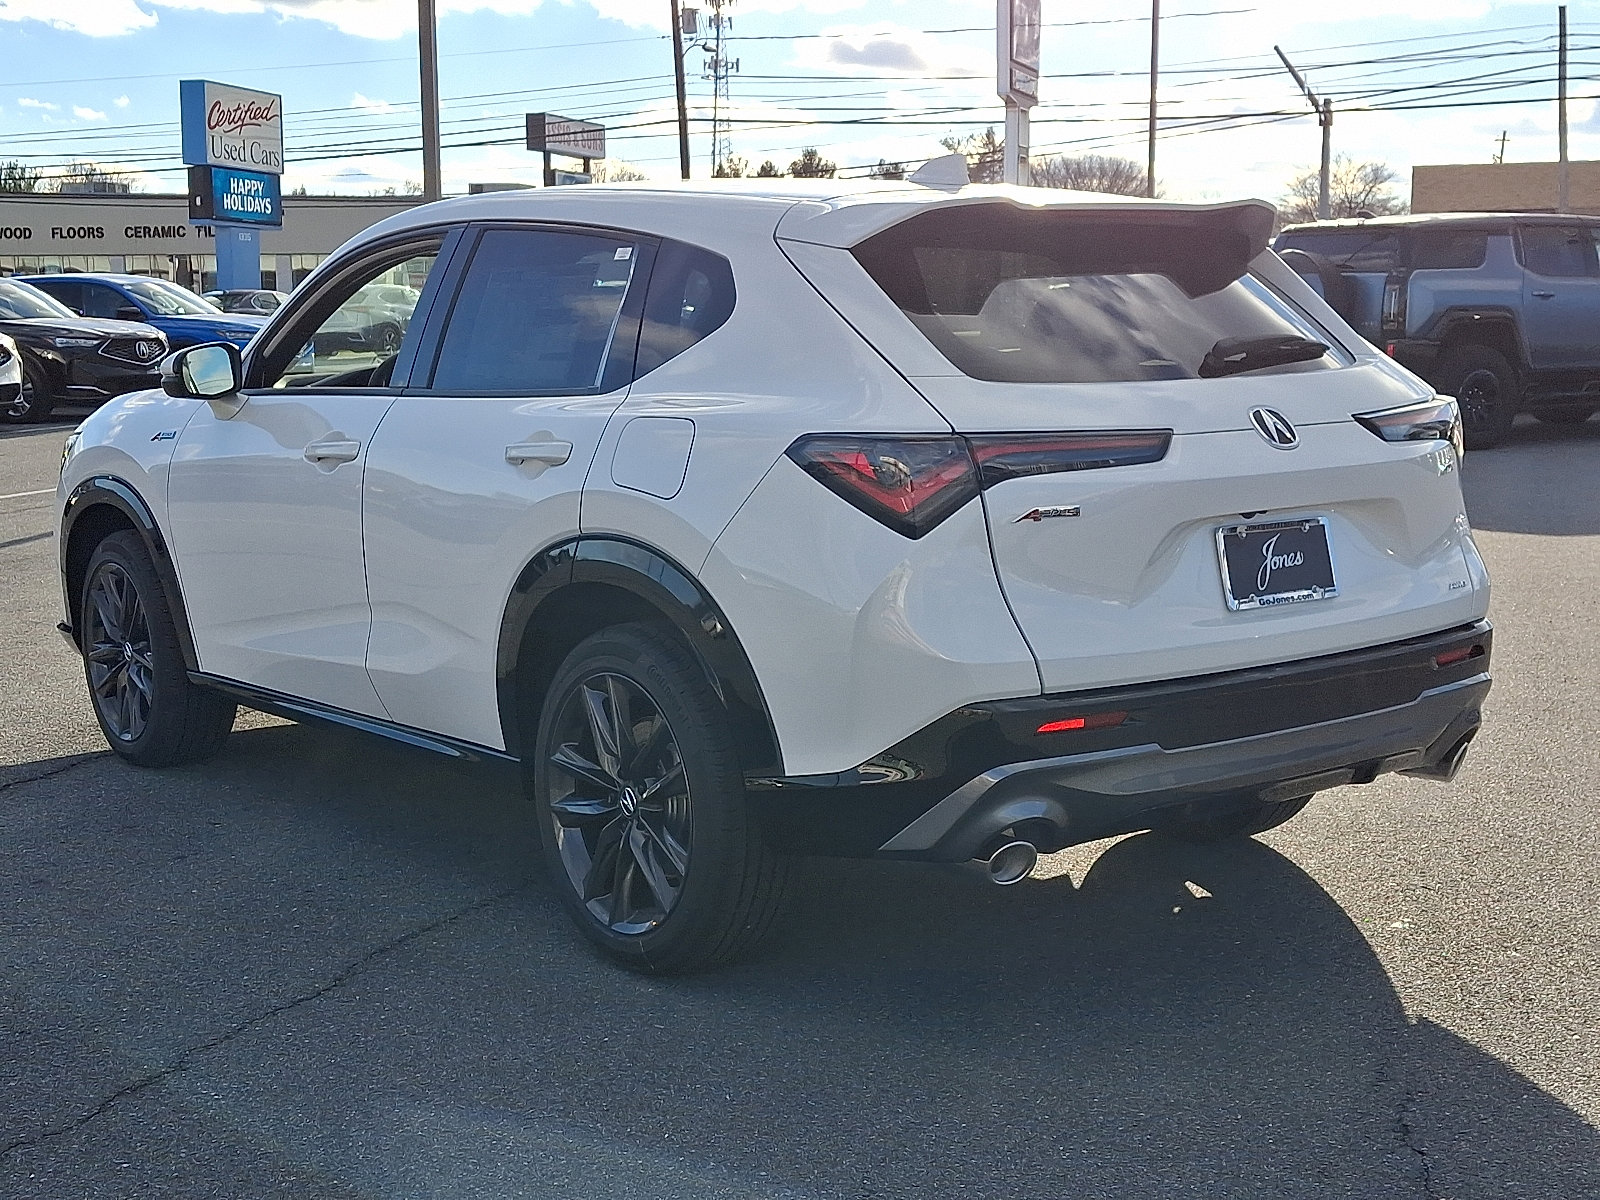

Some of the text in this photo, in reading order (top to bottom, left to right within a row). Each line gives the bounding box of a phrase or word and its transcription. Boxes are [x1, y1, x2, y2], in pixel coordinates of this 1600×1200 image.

[207, 99, 280, 135] Certified
[210, 134, 280, 168] Used Cars
[229, 177, 265, 197] HAPPY
[223, 193, 272, 215] HOLIDAYS
[51, 226, 105, 239] FLOORS
[124, 225, 187, 239] CERAMIC
[195, 225, 216, 239] TIL
[1257, 532, 1304, 591] Jones
[1258, 593, 1315, 606] GoJones.com
